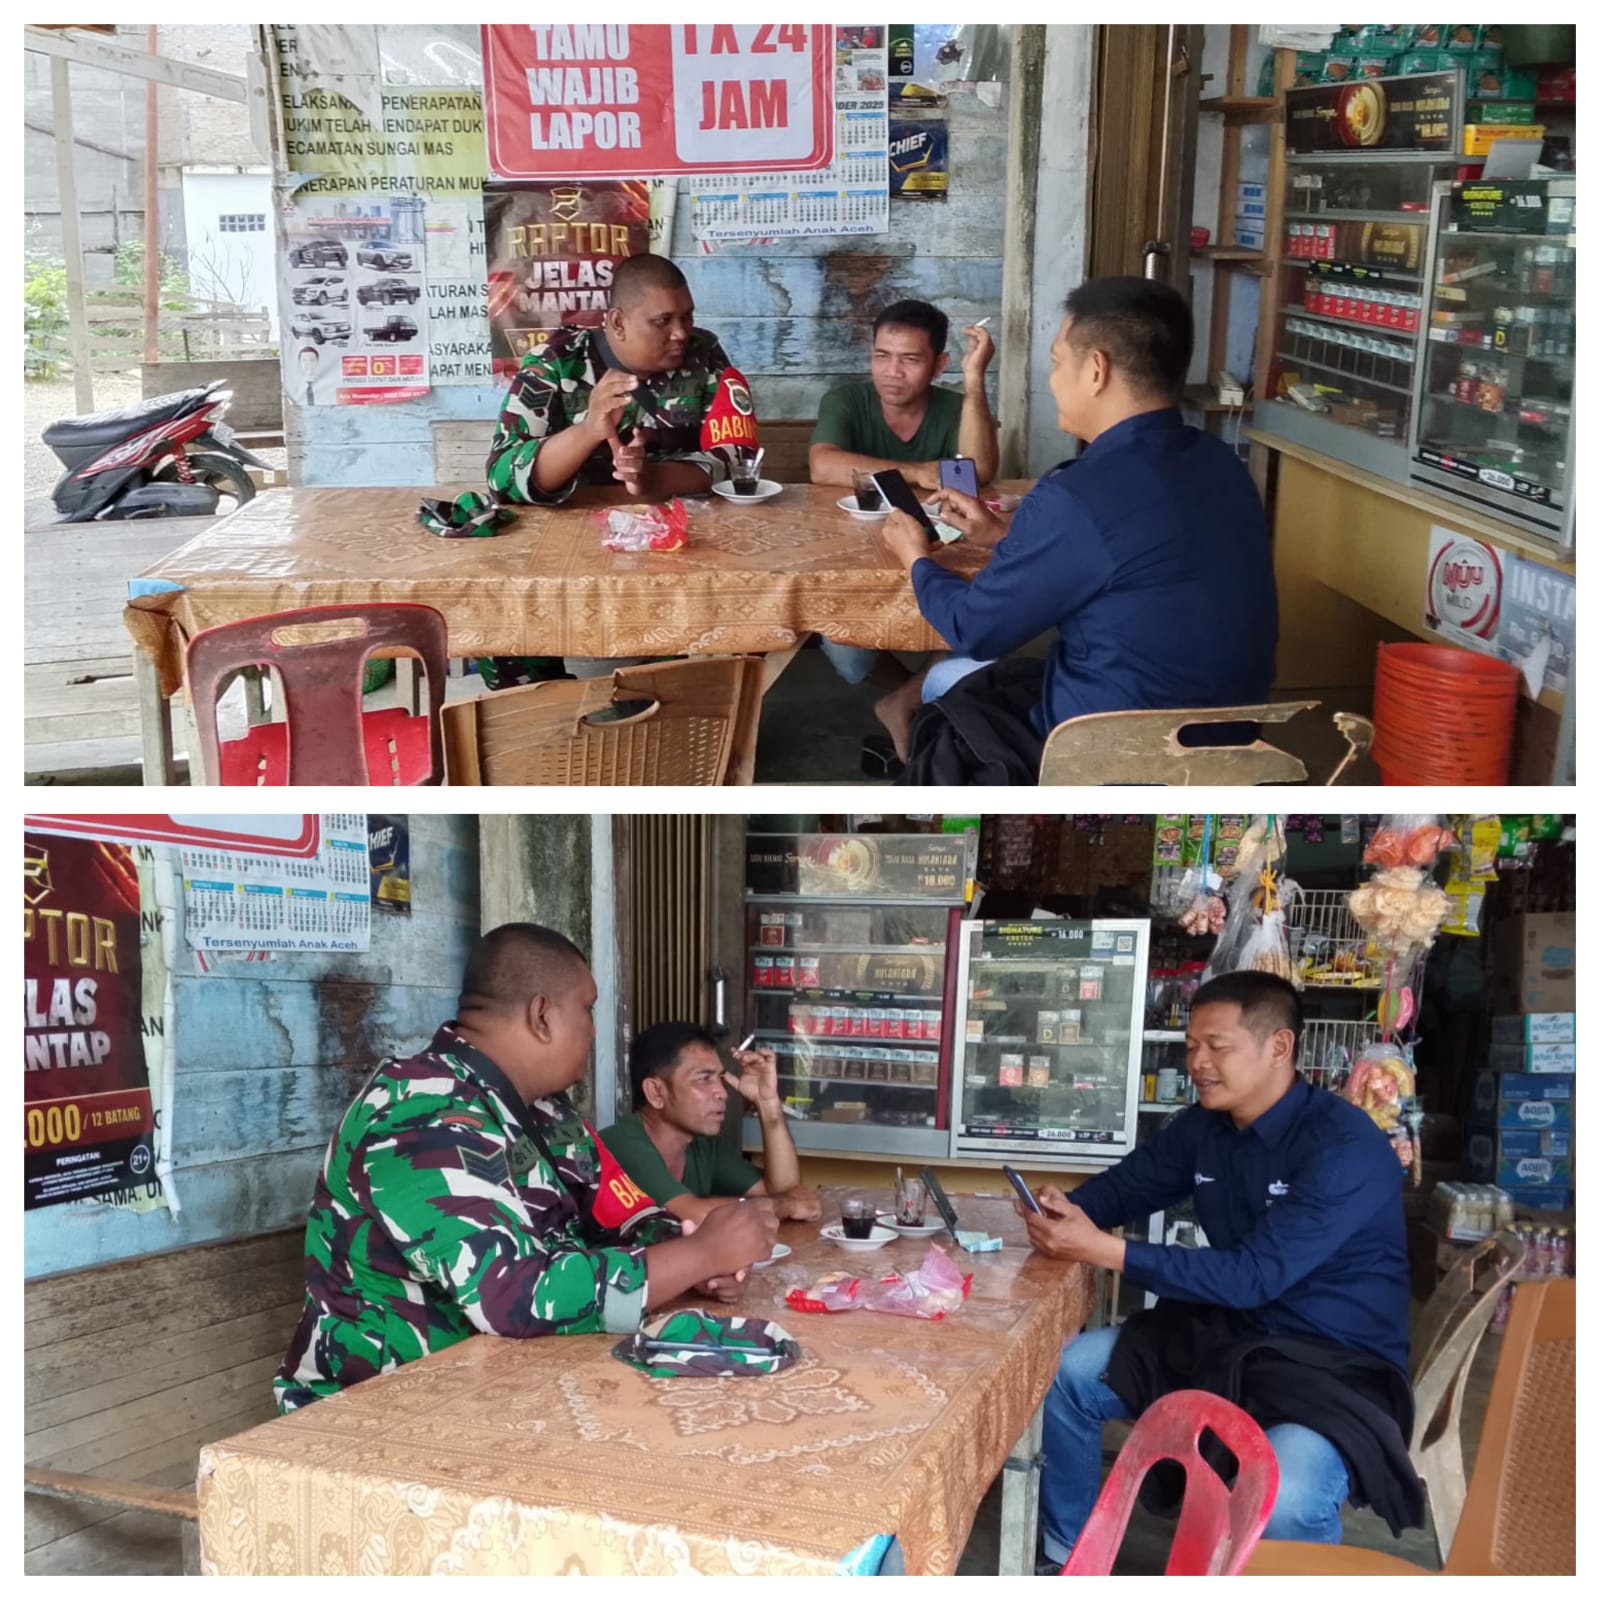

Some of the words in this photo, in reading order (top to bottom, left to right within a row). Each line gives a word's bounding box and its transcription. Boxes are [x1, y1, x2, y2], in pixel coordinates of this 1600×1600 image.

[531, 24, 631, 61] TAMU
[525, 67, 640, 106] WAJIB
[382, 95, 482, 110] PENERAPATAN
[699, 79, 789, 131] JAM
[860, 101, 884, 110] 2025
[284, 119, 322, 134] UKIM
[326, 118, 371, 133] TELAH
[381, 119, 450, 134] ENDAPAT
[531, 112, 642, 150] LAPOR
[287, 141, 364, 156] ECAMATAN
[367, 141, 420, 156] SUNGAI
[424, 141, 453, 156] MAS
[371, 176, 456, 192] PERATURAN
[507, 222, 631, 259] RAPTOR
[803, 226, 838, 236] Anak
[840, 225, 874, 234] Aceh
[524, 259, 615, 289] JELAS
[518, 289, 611, 312] MANTA
[370, 826, 394, 850] HIEF
[202, 936, 296, 950] Tersenyumlah
[299, 939, 327, 949] Anak
[330, 940, 358, 950] Aceh
[24, 977, 98, 1028] LAS
[24, 1031, 111, 1071] NTAP
[91, 1112, 103, 1127] 12
[105, 1106, 141, 1126] BATANG
[133, 1154, 148, 1166] 21+
